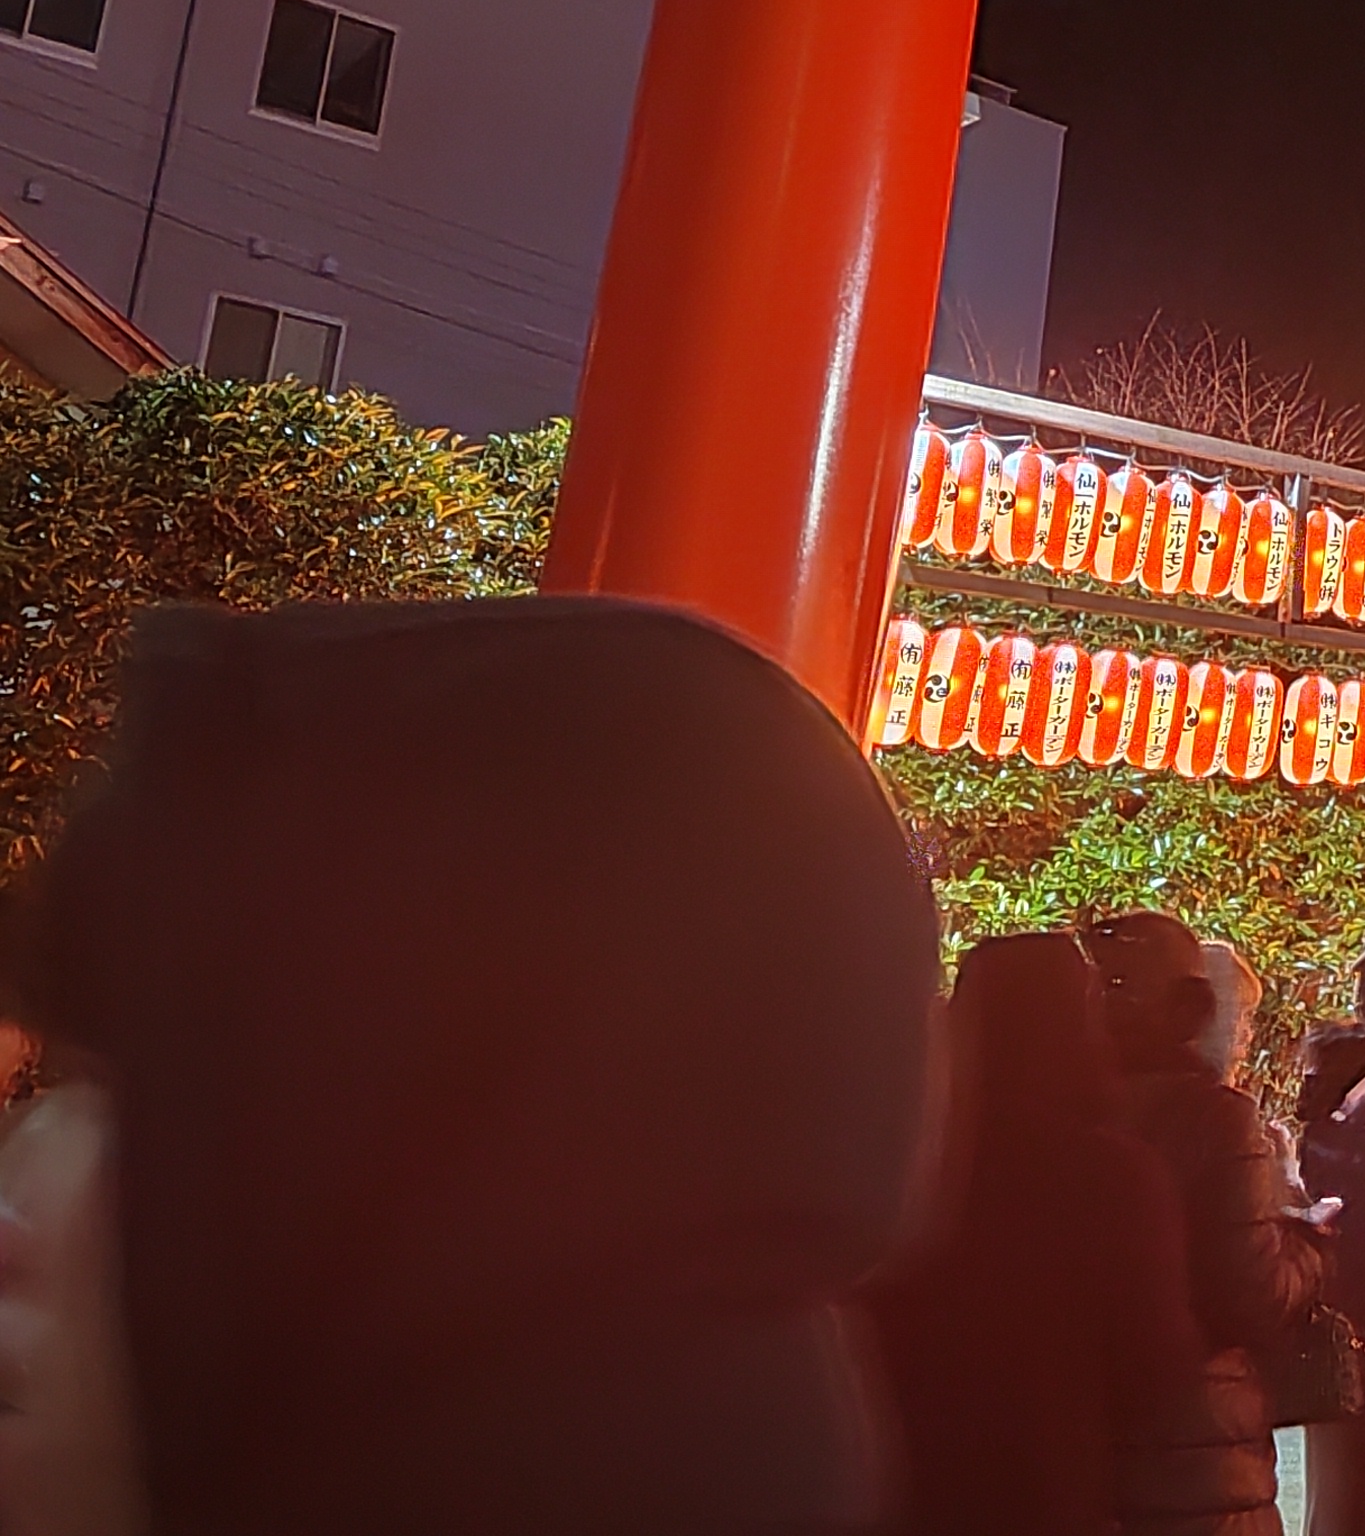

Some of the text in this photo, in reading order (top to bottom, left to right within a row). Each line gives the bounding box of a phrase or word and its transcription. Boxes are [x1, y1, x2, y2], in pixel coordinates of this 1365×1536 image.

[1069, 473, 1096, 558] 仙一ホルモン
[1165, 493, 1190, 579] 仙一ホルモン
[1267, 511, 1288, 592] 仙一ホルモン
